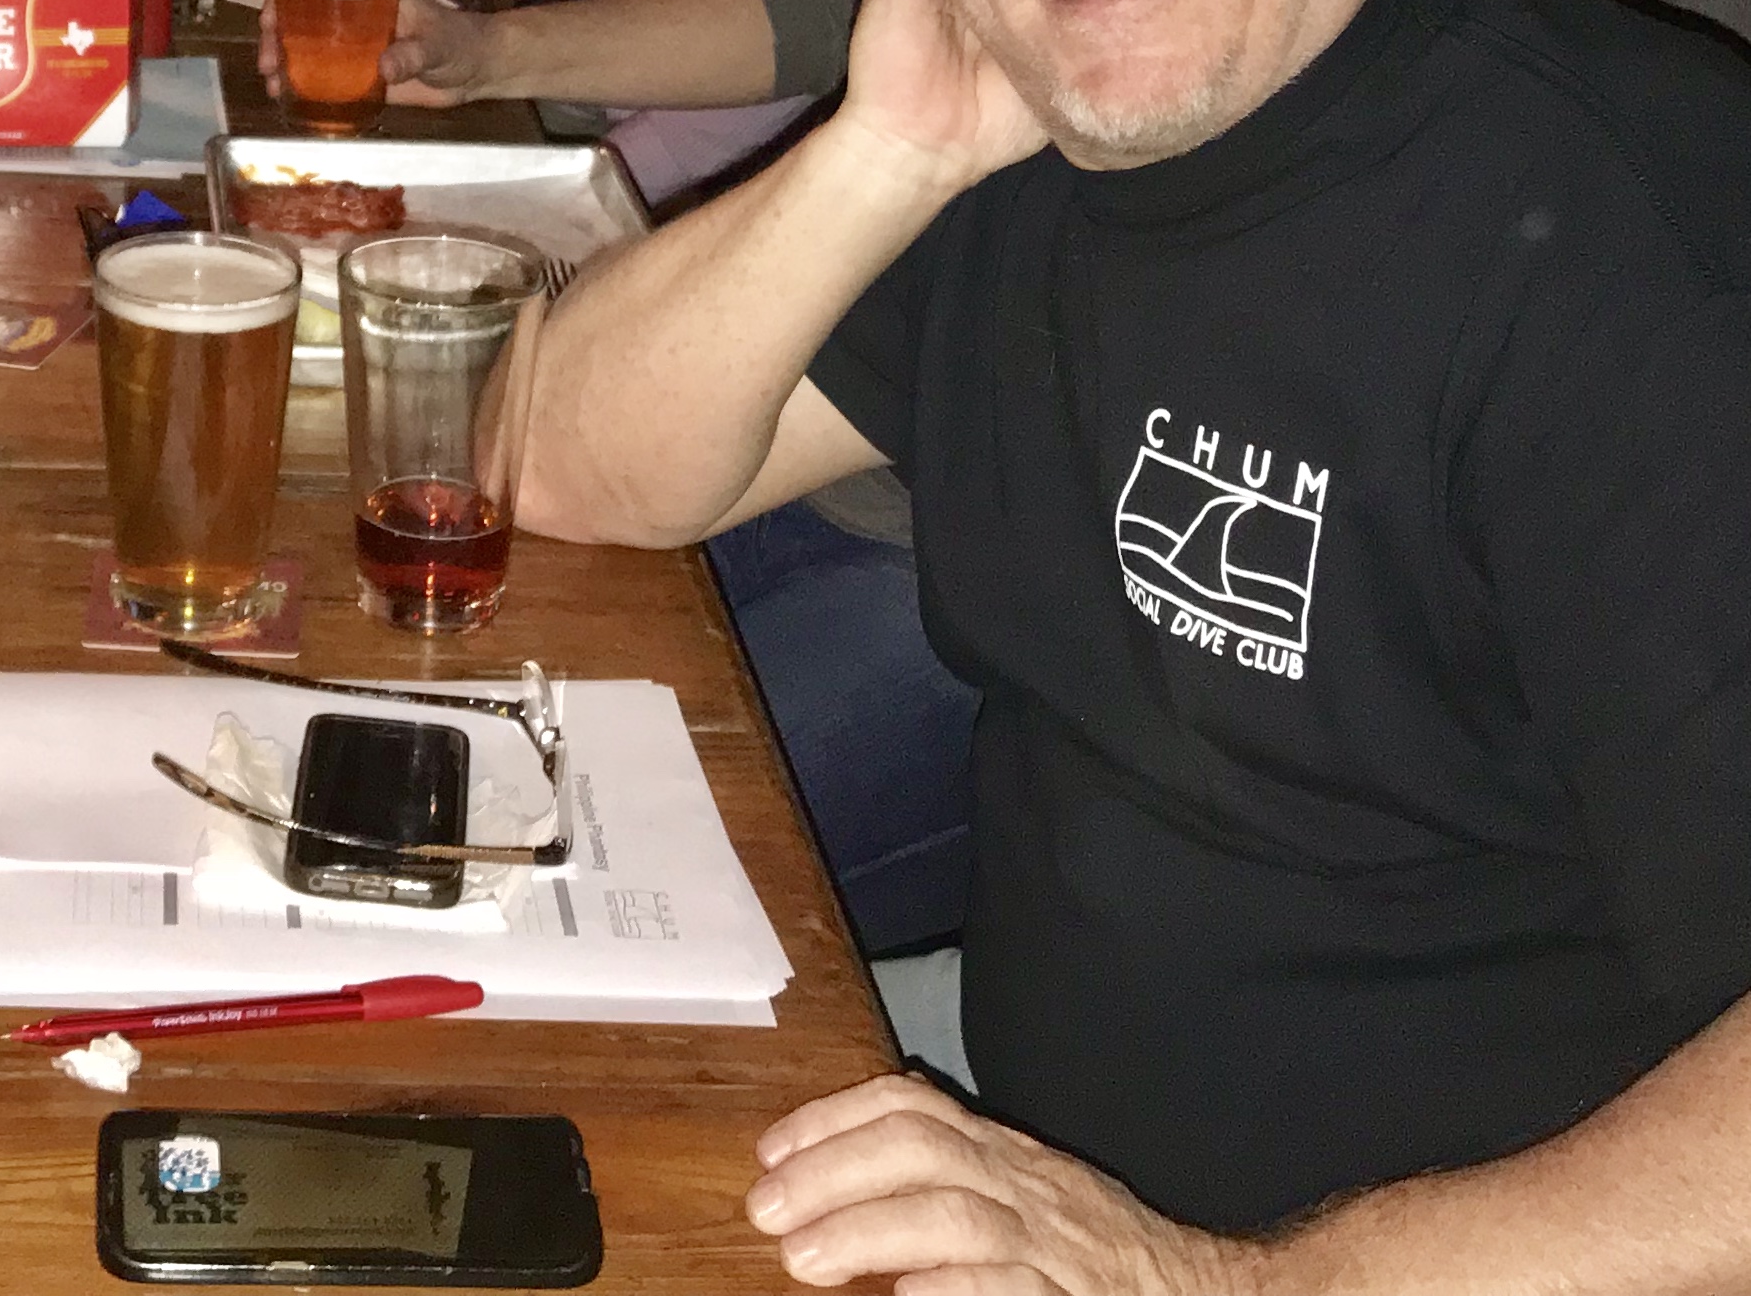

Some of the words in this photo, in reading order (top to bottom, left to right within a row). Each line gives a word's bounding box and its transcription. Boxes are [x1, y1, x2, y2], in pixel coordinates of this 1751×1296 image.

[1145, 408, 1329, 512] CHUM
[1123, 575, 1161, 625] SOCIAL
[1170, 613, 1228, 657] DIVE
[1235, 639, 1304, 681] CLUB
